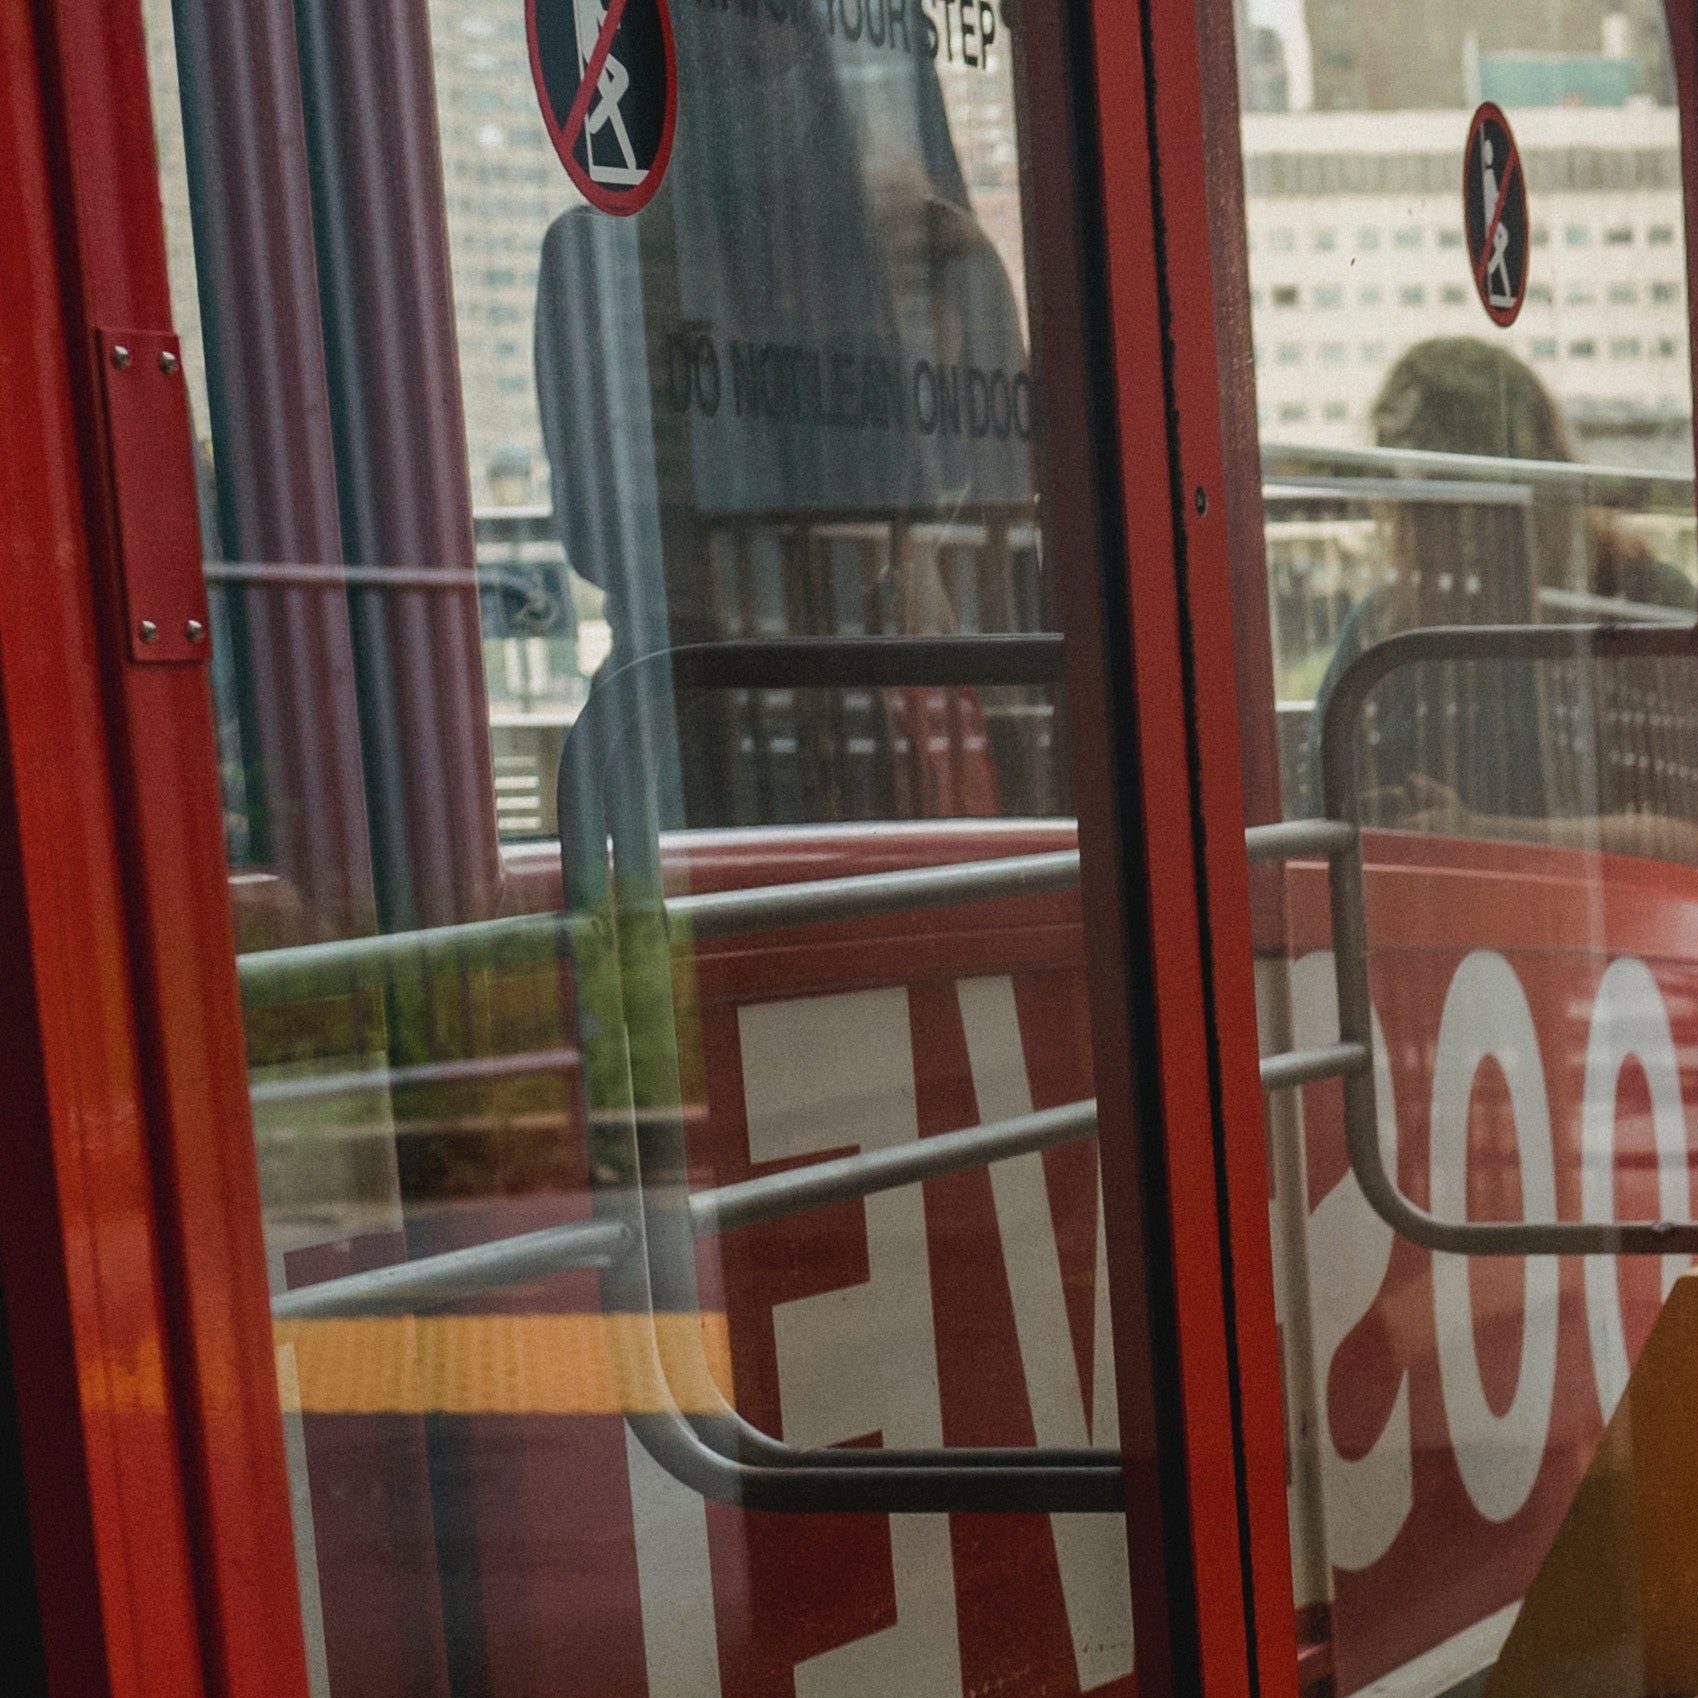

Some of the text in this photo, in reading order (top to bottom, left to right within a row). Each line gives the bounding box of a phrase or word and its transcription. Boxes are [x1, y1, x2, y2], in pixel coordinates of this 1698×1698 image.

[917, 0, 995, 71] STEP
[664, 332, 720, 418] DO
[914, 360, 962, 435] ON
[964, 367, 1034, 441] DOO
